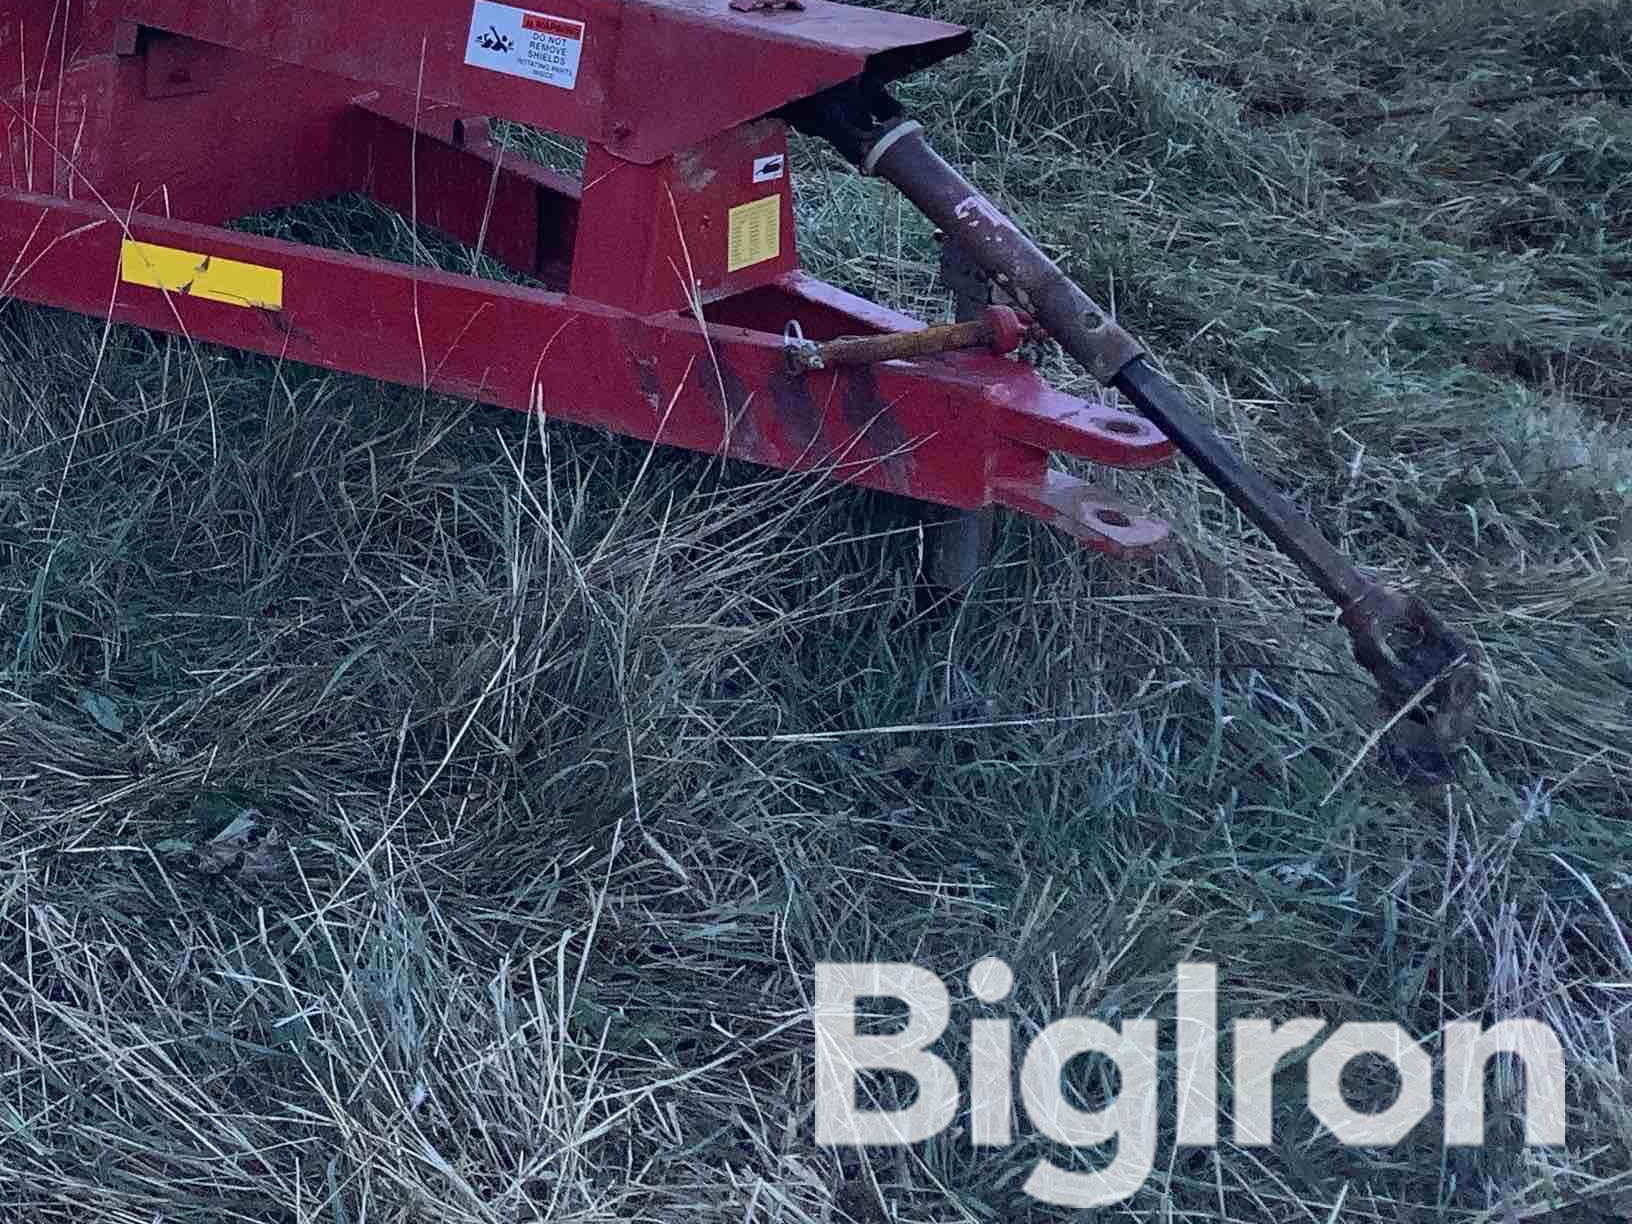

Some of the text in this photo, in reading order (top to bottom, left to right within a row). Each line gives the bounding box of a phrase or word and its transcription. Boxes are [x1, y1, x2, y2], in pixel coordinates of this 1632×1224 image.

[533, 32, 567, 47] DO NOT
[529, 41, 568, 56] REMOVE
[528, 50, 566, 65] SHIELDS
